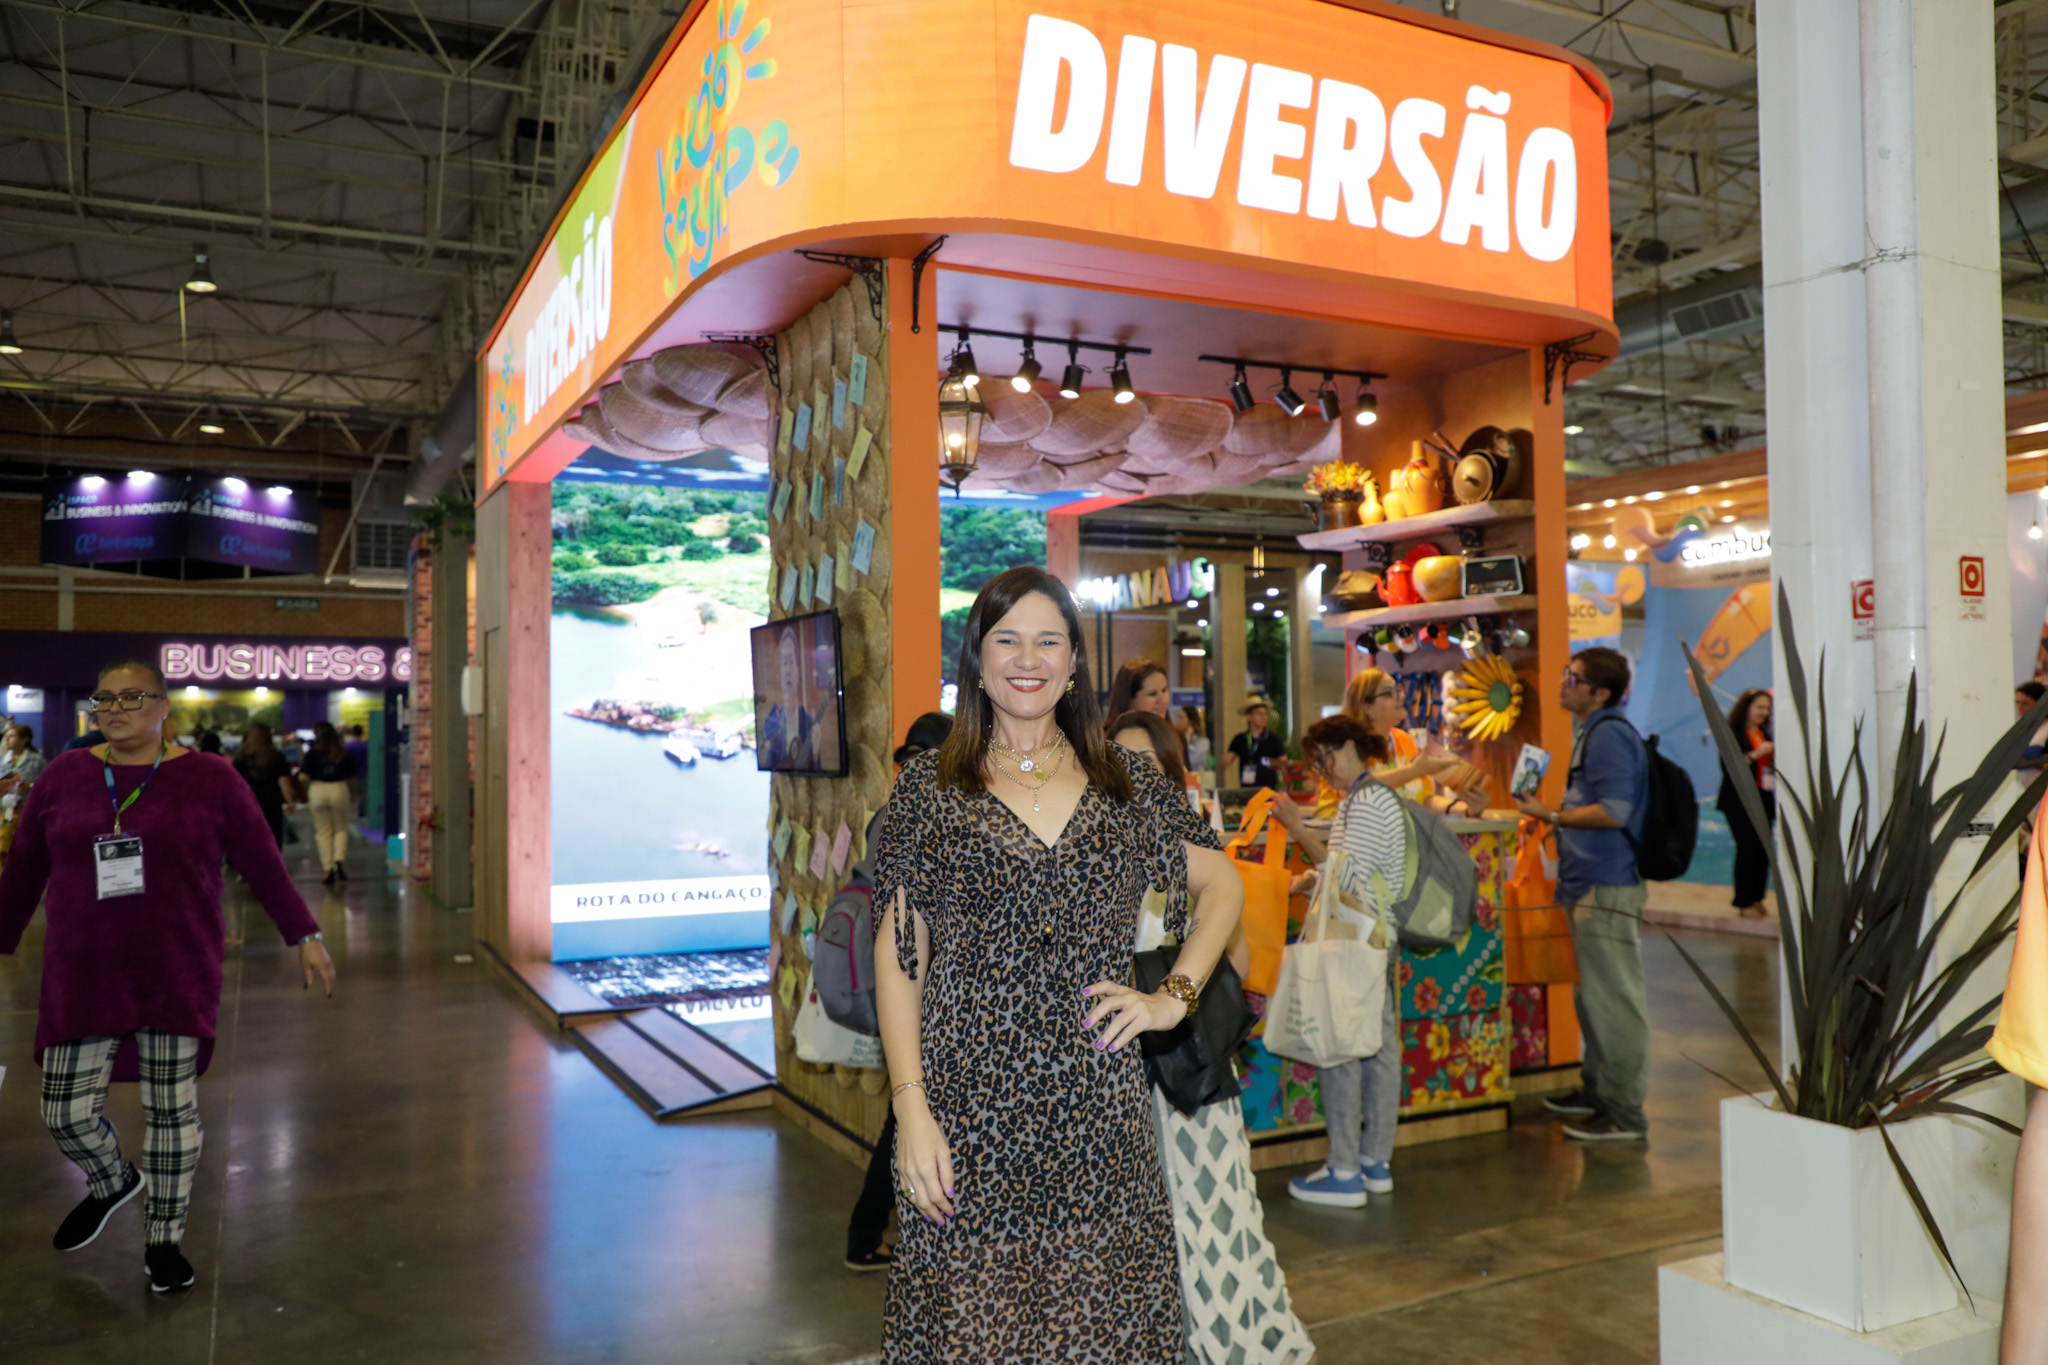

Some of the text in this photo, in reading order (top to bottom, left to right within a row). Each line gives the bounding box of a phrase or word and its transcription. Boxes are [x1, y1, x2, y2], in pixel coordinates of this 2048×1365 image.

[1009, 14, 1578, 263] DIVERSÃO
[523, 210, 614, 426] DIVERSÃO
[66, 501, 188, 519] BUSINESS & INNOVATION
[211, 504, 256, 524] BUSINESS
[264, 513, 318, 535] INNOVATION
[1681, 526, 1770, 563] cumbu
[1092, 556, 1210, 612] MANAUS
[161, 643, 386, 681] BUSINESS
[576, 894, 632, 908] ROTA
[638, 891, 665, 904] DO
